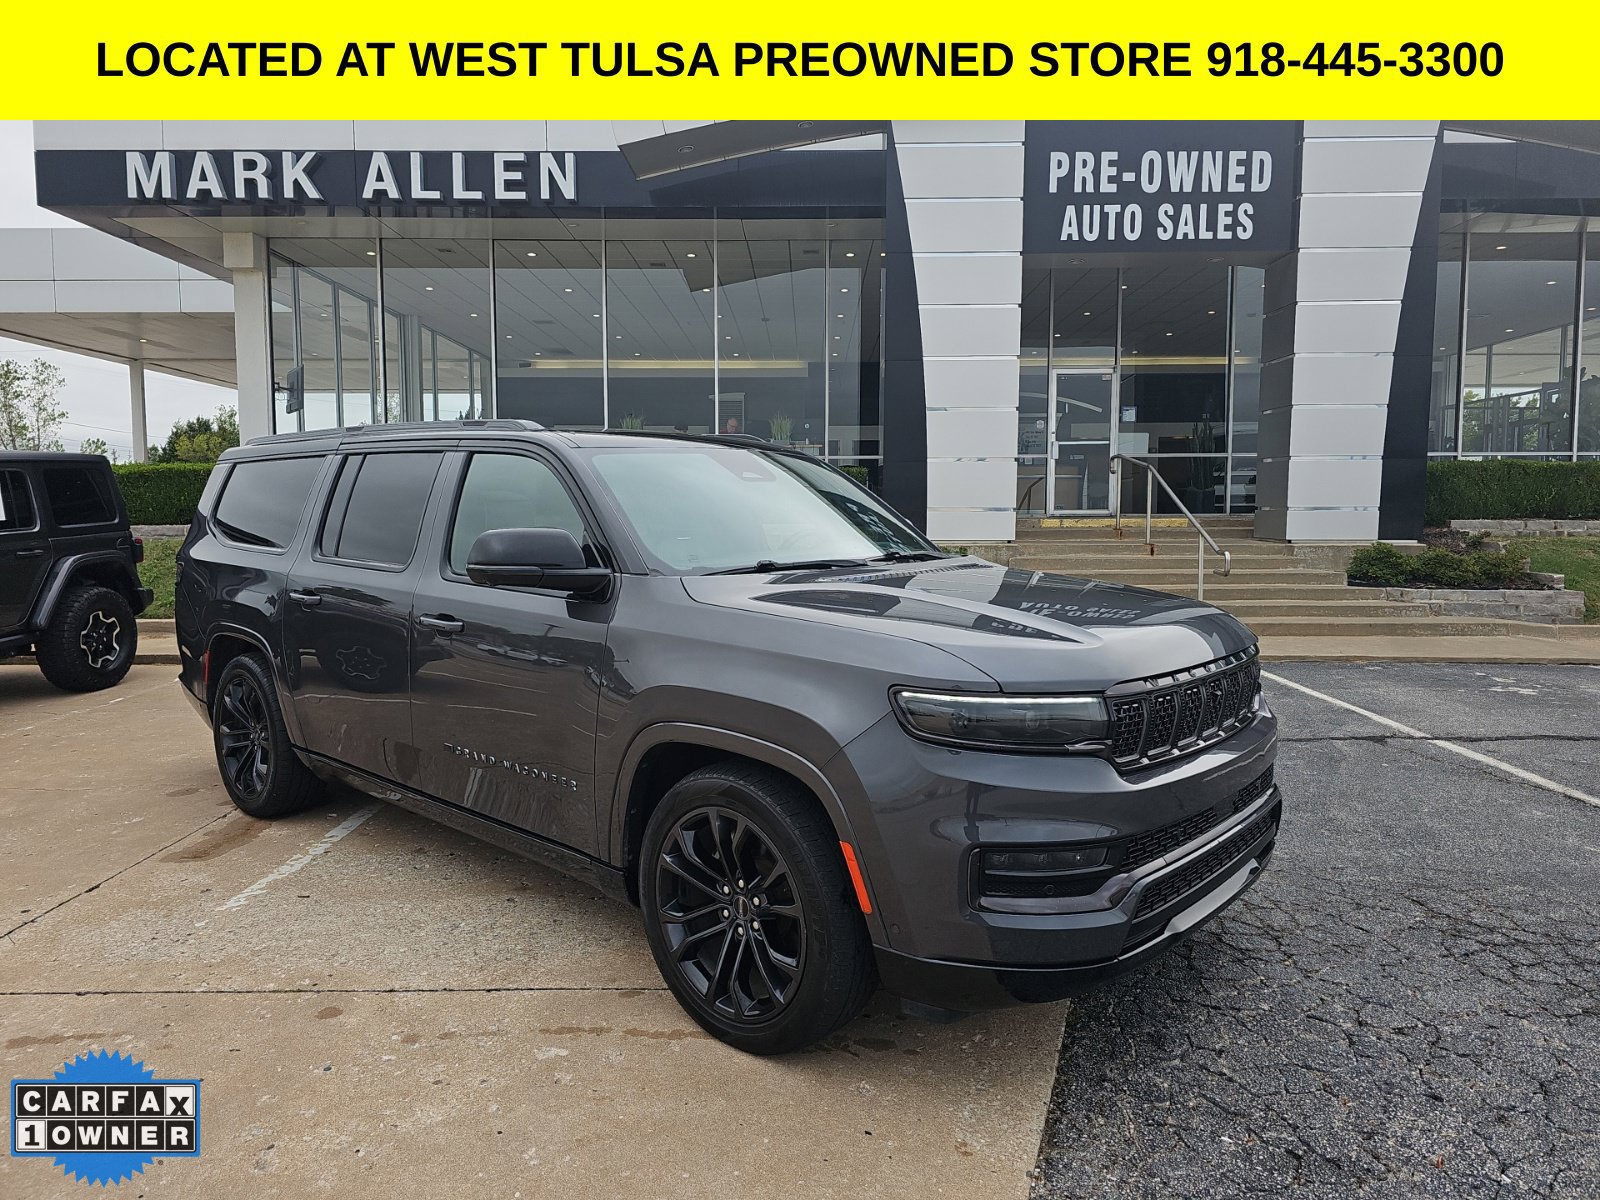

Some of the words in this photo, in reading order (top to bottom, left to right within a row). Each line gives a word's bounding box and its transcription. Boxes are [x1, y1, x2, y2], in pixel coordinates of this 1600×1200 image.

[125, 151, 324, 200] MARK
[362, 151, 577, 201] ALLEN
[1049, 150, 1273, 194] PRE-OWNED
[1060, 203, 1143, 241] AUTO
[1156, 202, 1254, 241] SALES
[455, 746, 496, 765] GRAND
[503, 760, 577, 791] WAGONEER
